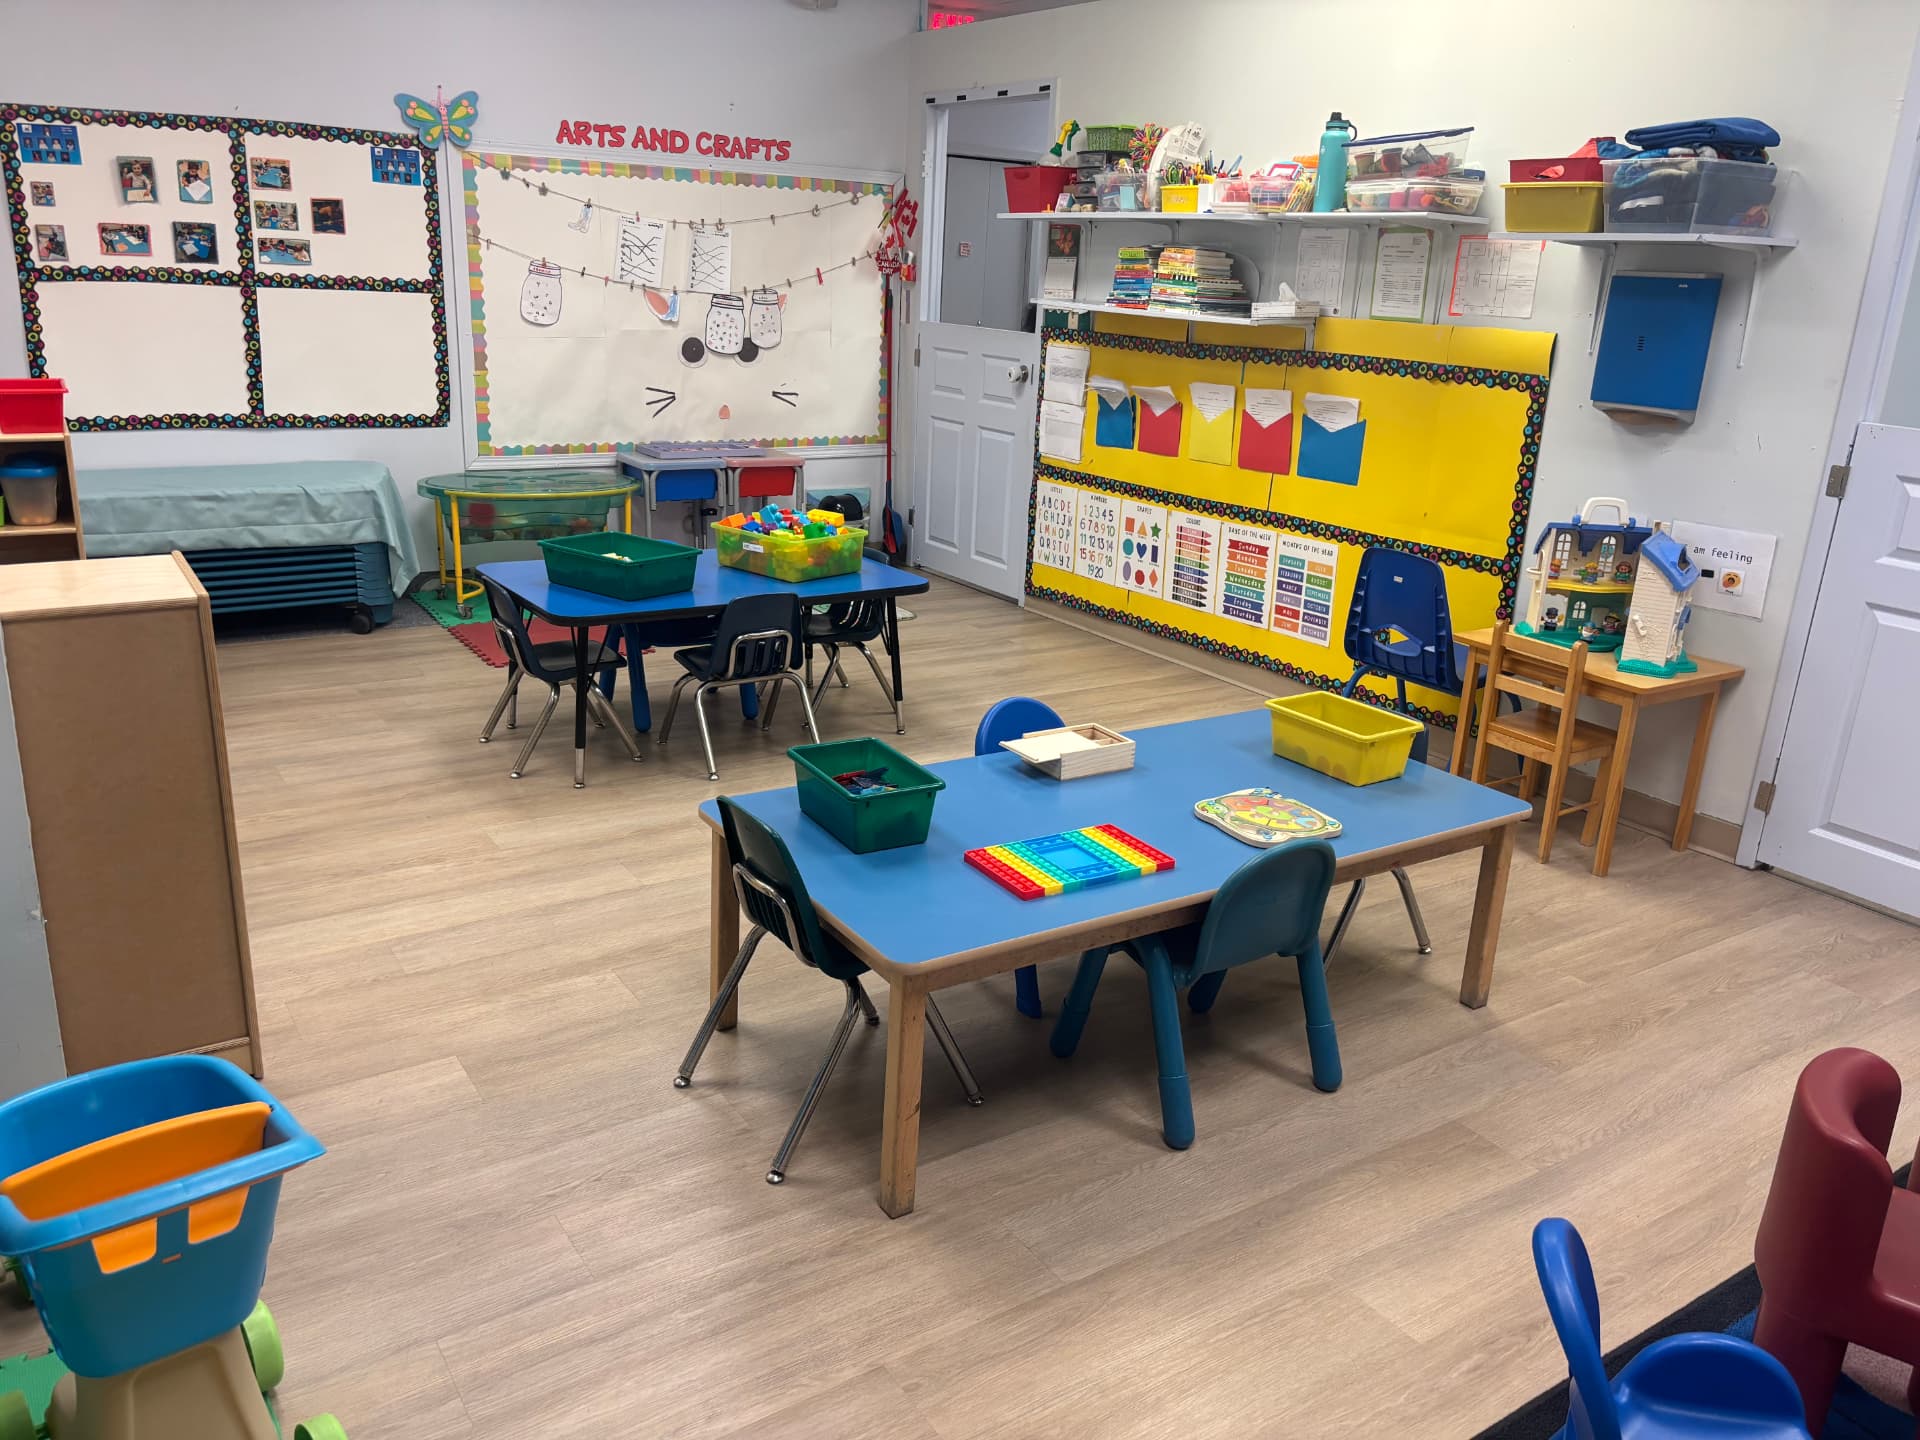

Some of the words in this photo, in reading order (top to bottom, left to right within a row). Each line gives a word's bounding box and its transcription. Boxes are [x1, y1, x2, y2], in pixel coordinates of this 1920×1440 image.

[556, 119, 626, 148] ARTS
[631, 125, 689, 153] AND
[695, 131, 792, 162] CRAFTS
[1080, 518, 1085, 530] 6
[1088, 519, 1092, 531] 7
[1094, 521, 1099, 533] 8
[1101, 523, 1105, 534] 9
[1107, 525, 1115, 537] 10
[1080, 533, 1087, 545] 11
[1089, 535, 1096, 547] 12
[1097, 537, 1104, 550] 13
[1106, 540, 1113, 552] 14
[1238, 542, 1259, 554] Sunday
[1080, 547, 1087, 559] 15
[1088, 550, 1095, 562] 16
[1105, 555, 1112, 567] 18
[1236, 553, 1258, 565] Monday
[1693, 545, 1706, 555] am
[1711, 547, 1753, 564] feeling
[1088, 563, 1094, 575] 19
[1095, 566, 1104, 578] 20
[1234, 563, 1257, 576] Tuesday
[1229, 575, 1261, 588] Wednesday
[1231, 585, 1257, 599] Thursday
[1233, 598, 1252, 608] Friday
[1229, 607, 1255, 621] Saturday
